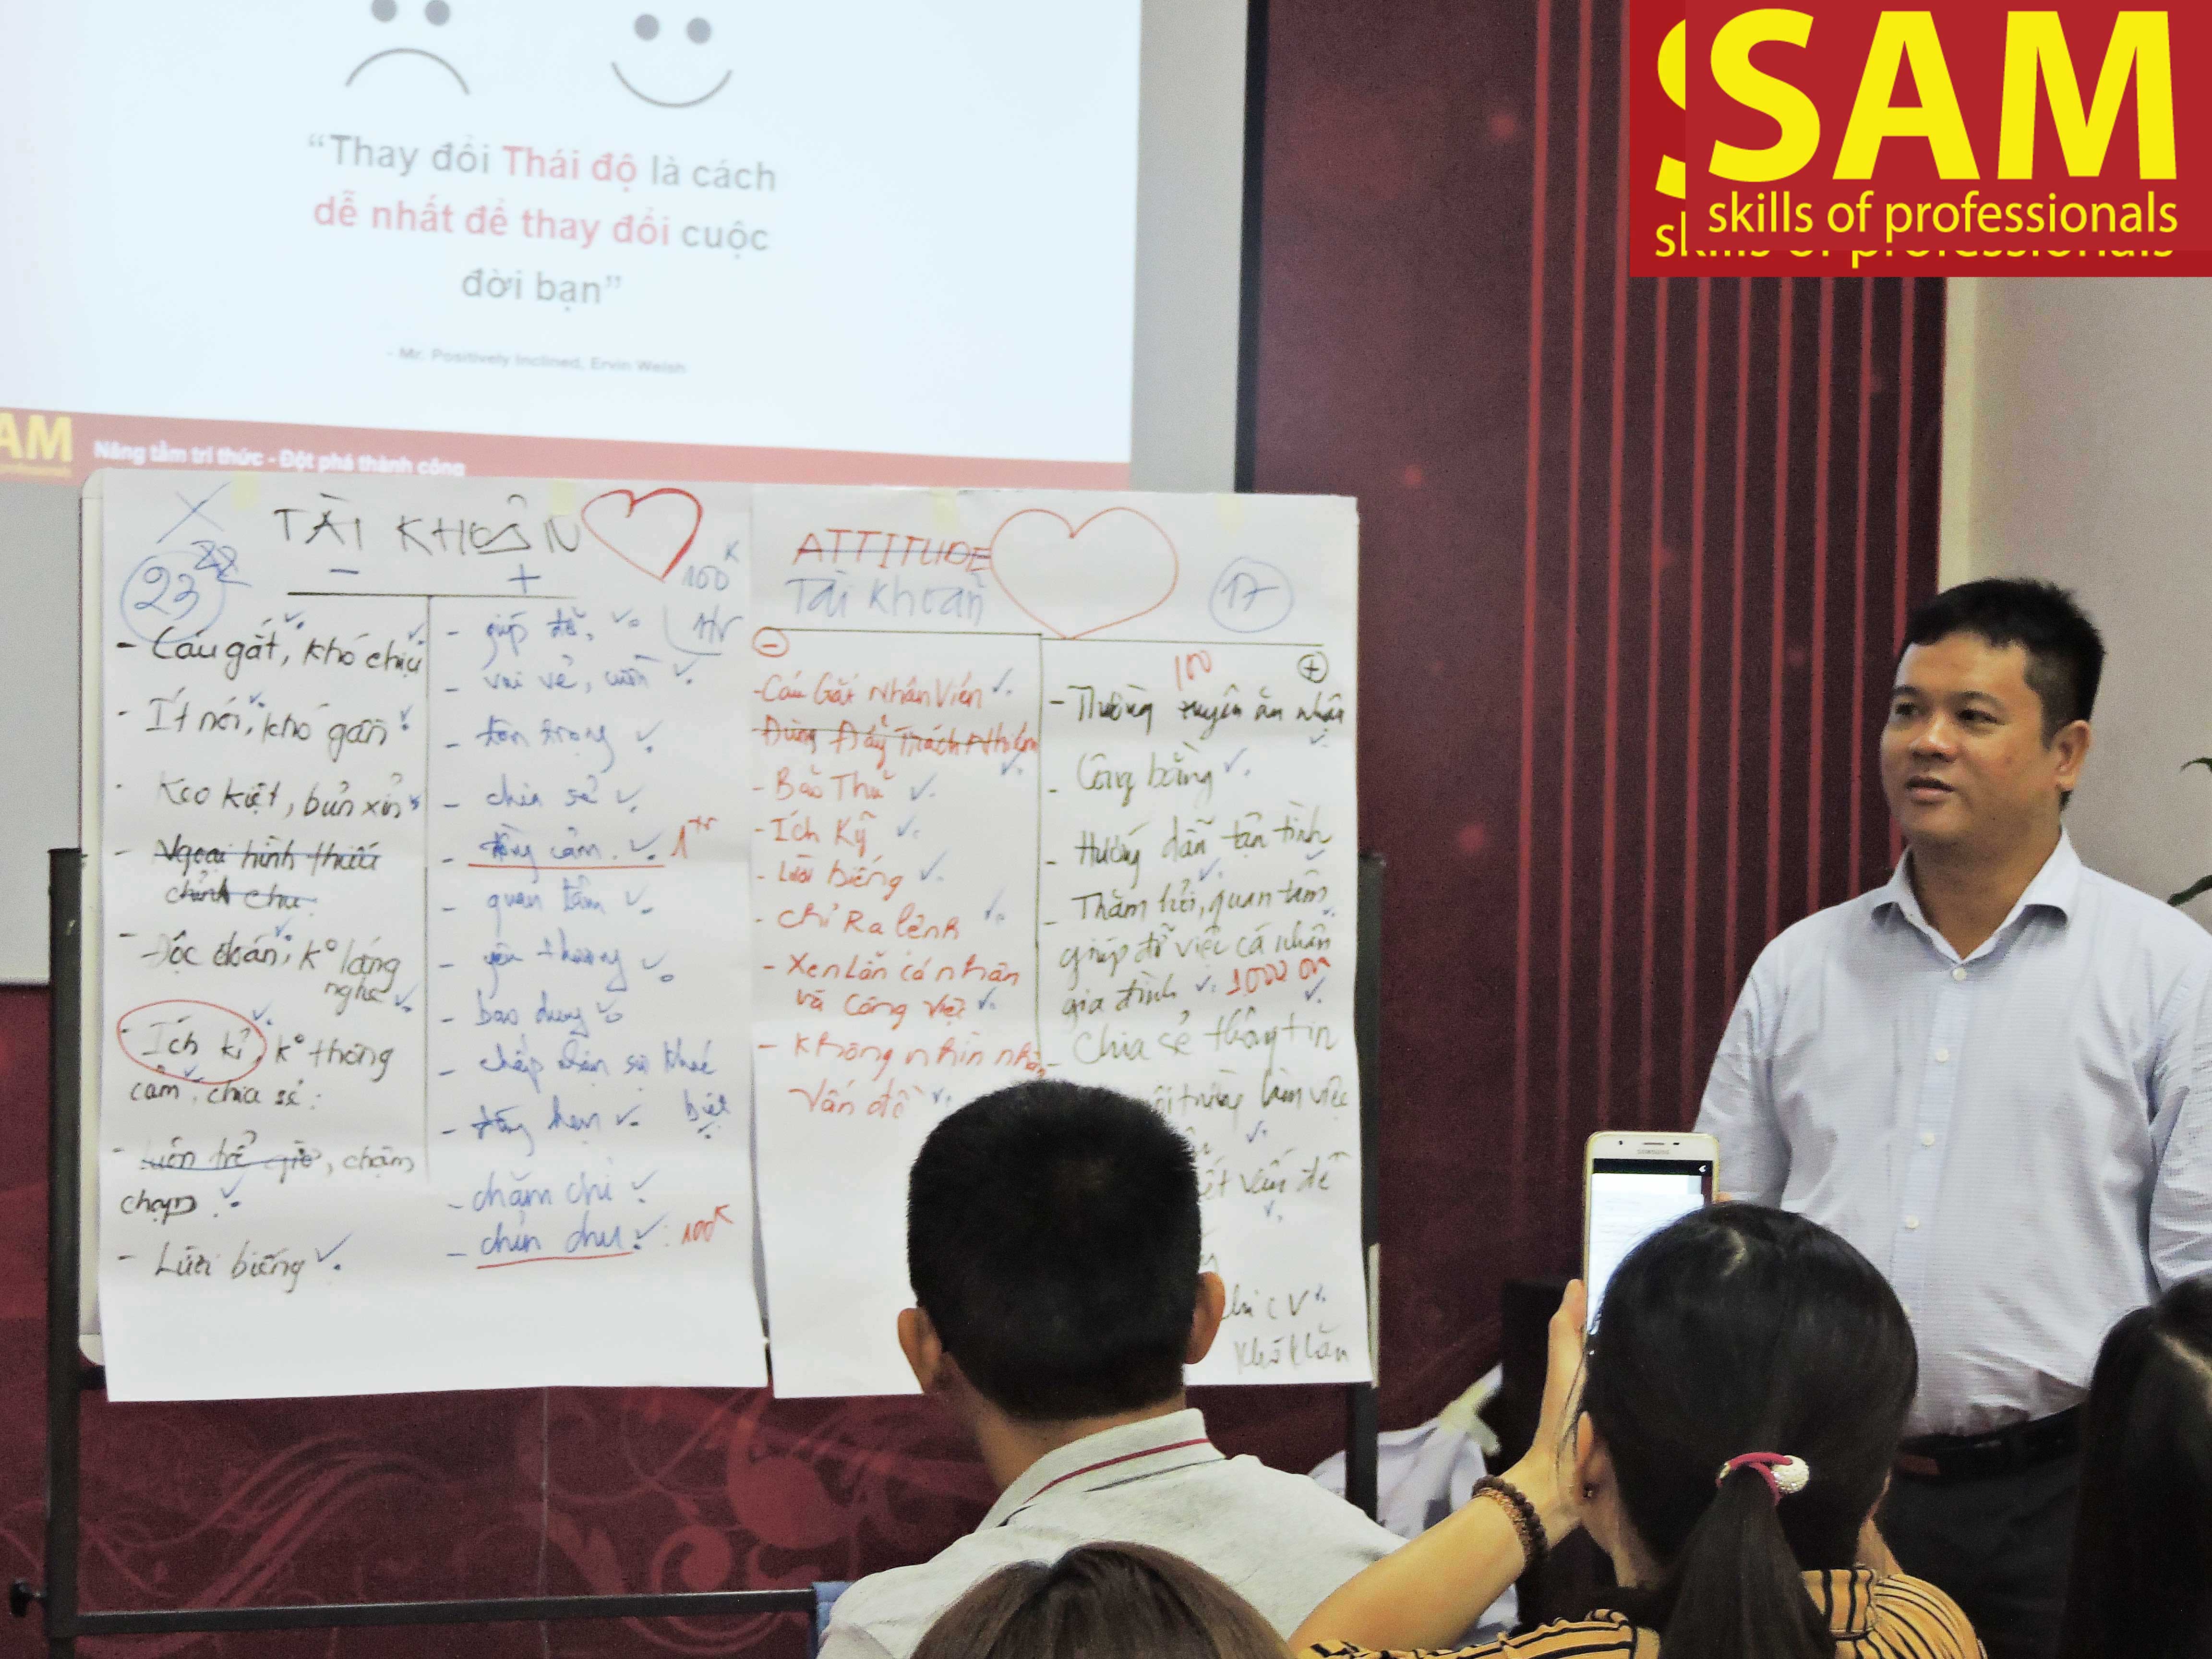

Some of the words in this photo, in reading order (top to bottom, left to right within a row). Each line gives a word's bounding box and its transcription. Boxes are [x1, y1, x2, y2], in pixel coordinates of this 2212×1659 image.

[503, 145, 580, 181] Thái
[591, 152, 637, 192] độ
[651, 155, 679, 188] là
[692, 158, 776, 192] cách
[313, 191, 357, 227] dễ
[372, 193, 453, 234] nhất
[522, 209, 600, 249] thay
[682, 220, 769, 260] cuộc
[461, 268, 522, 299] đời
[431, 349, 511, 368] Positively
[793, 528, 991, 572] ATTITUDE
[134, 566, 200, 621] 23
